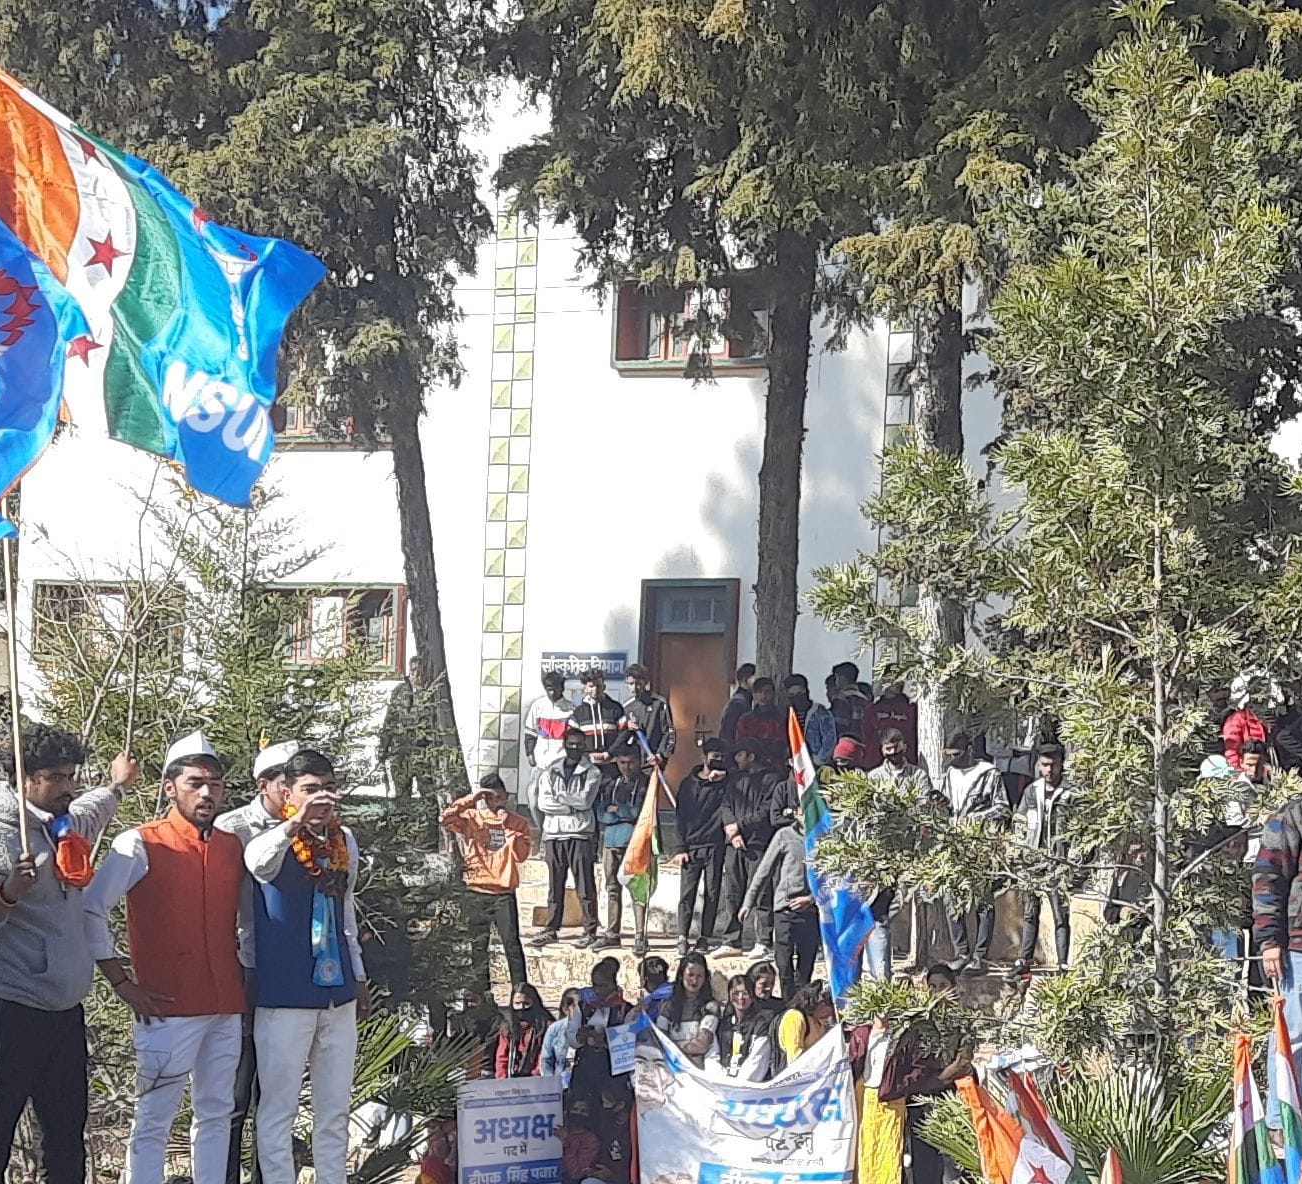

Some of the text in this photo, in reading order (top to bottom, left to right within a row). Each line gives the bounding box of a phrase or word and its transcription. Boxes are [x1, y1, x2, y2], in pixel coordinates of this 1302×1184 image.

[473, 1114, 556, 1144] अध्यक्ष
[506, 1165, 529, 1183] सिंह
[530, 1166, 559, 1179] पवार
